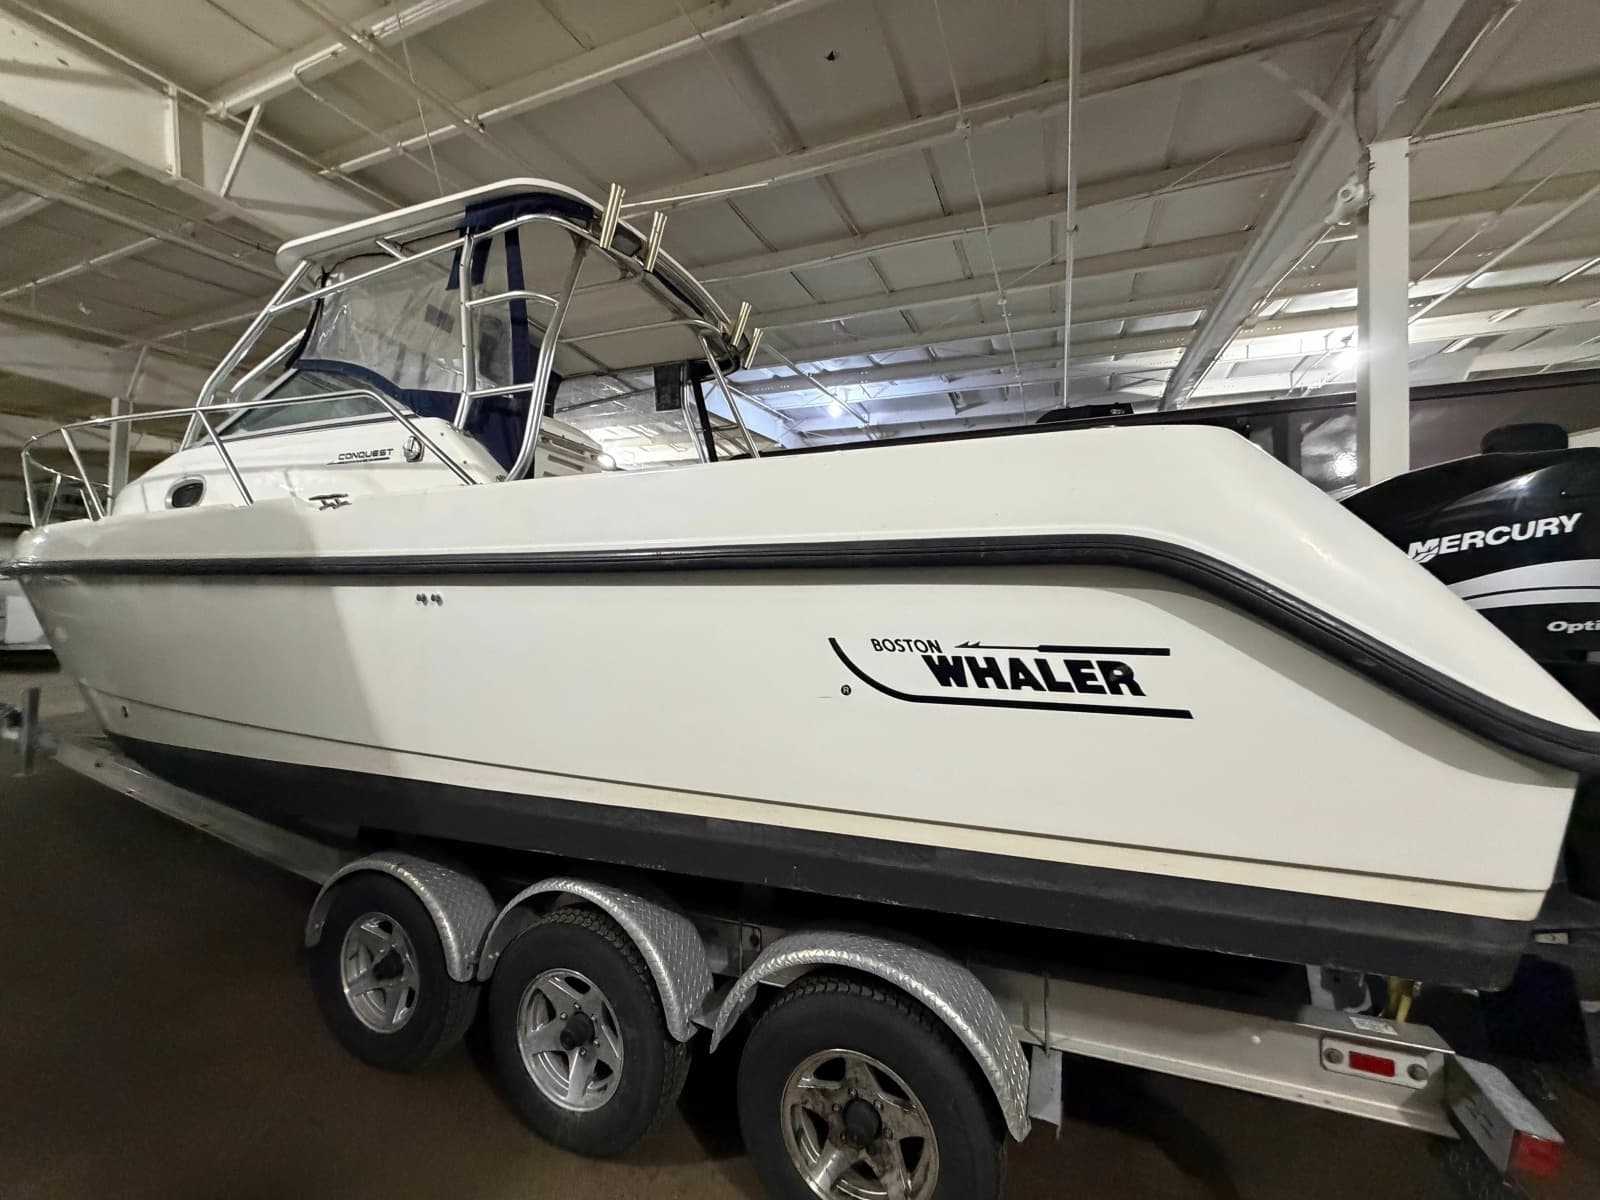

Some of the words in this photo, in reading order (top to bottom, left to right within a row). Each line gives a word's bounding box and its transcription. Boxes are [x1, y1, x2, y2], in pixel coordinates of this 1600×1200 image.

[338, 448, 394, 461] CONQUEST
[1407, 512, 1583, 564] MERCURY
[871, 638, 943, 654] BOSTON
[921, 654, 1146, 697] WHALER
